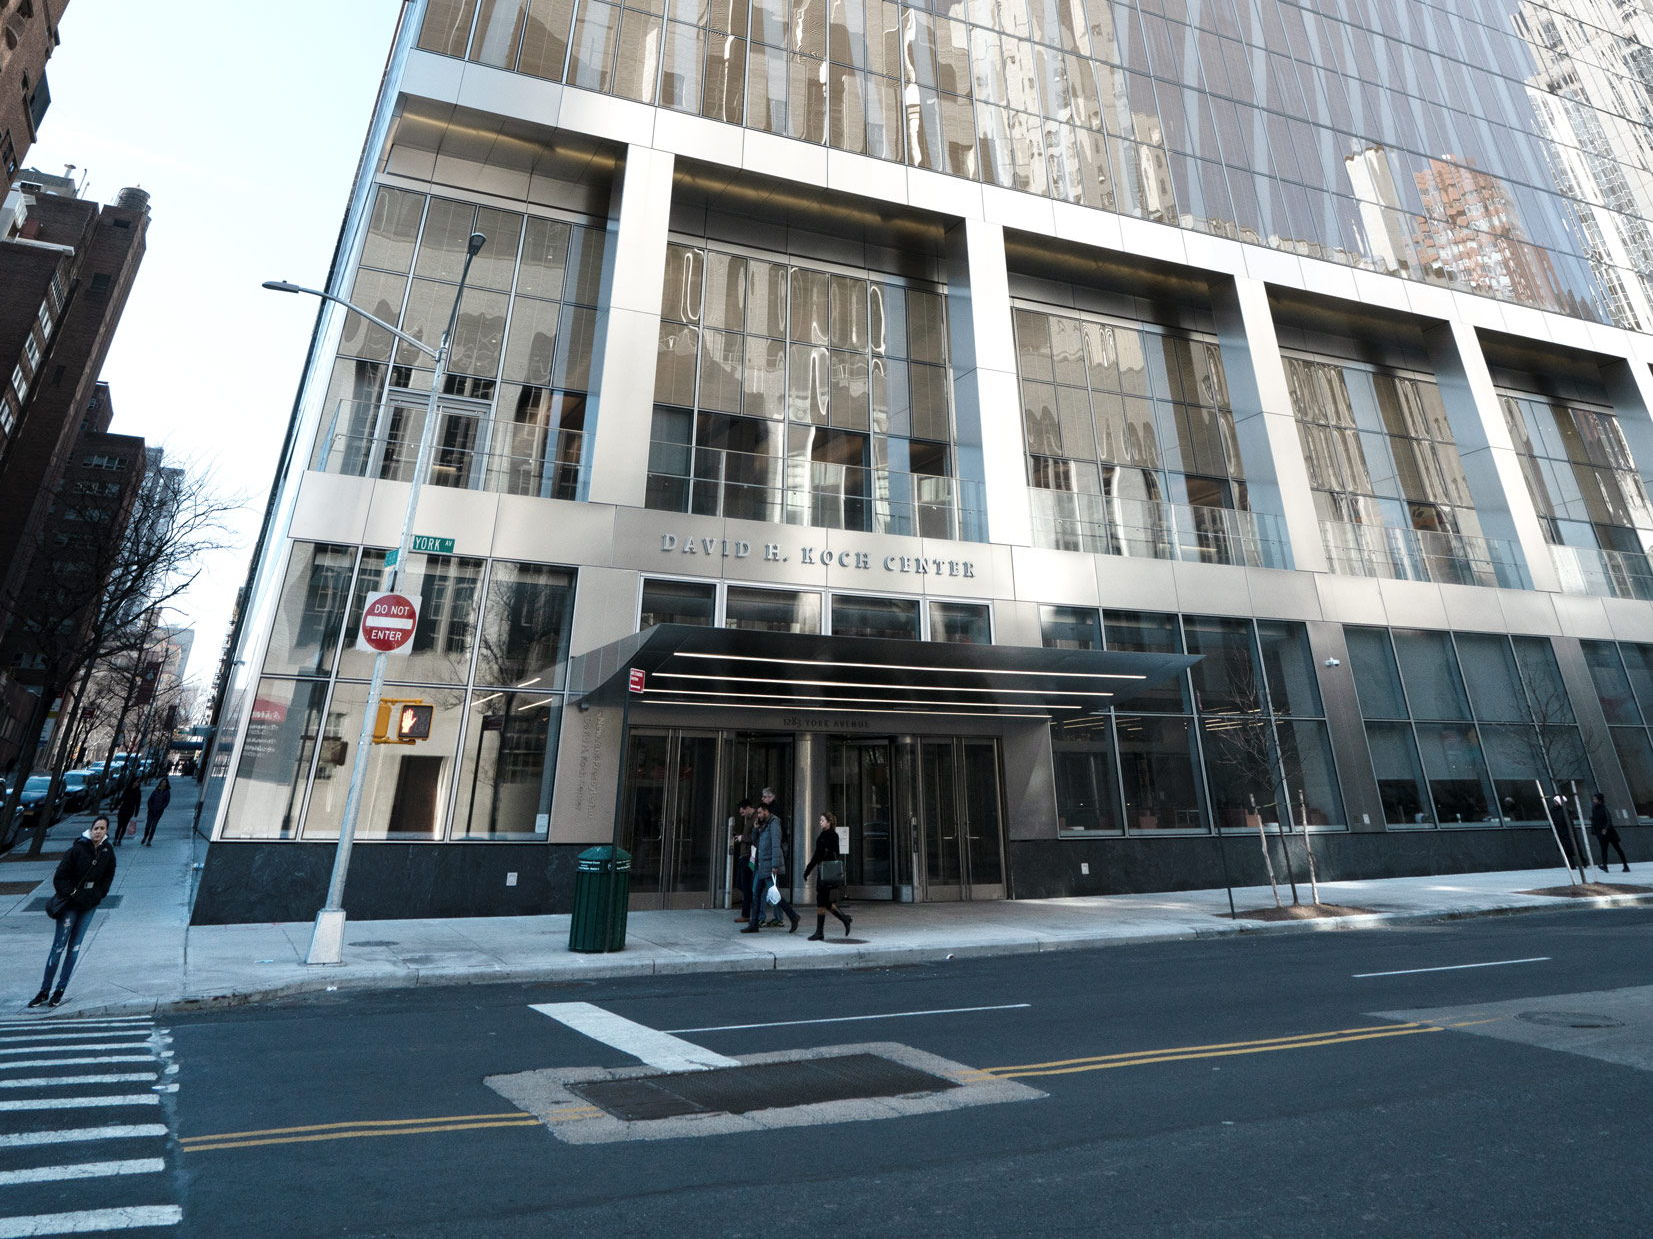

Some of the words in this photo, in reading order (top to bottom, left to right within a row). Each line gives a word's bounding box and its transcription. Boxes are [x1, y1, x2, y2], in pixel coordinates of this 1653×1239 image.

[415, 536, 441, 551] YORK
[661, 533, 751, 558] DAVID
[764, 542, 789, 562] H.
[800, 546, 871, 570] KOCH
[883, 555, 976, 578] CENTER
[374, 604, 388, 614] DO
[390, 606, 410, 616] NOT
[371, 629, 402, 641] ENTER
[783, 717, 802, 728] 1283
[805, 719, 830, 728] YORK
[833, 720, 869, 729] AVENUE
